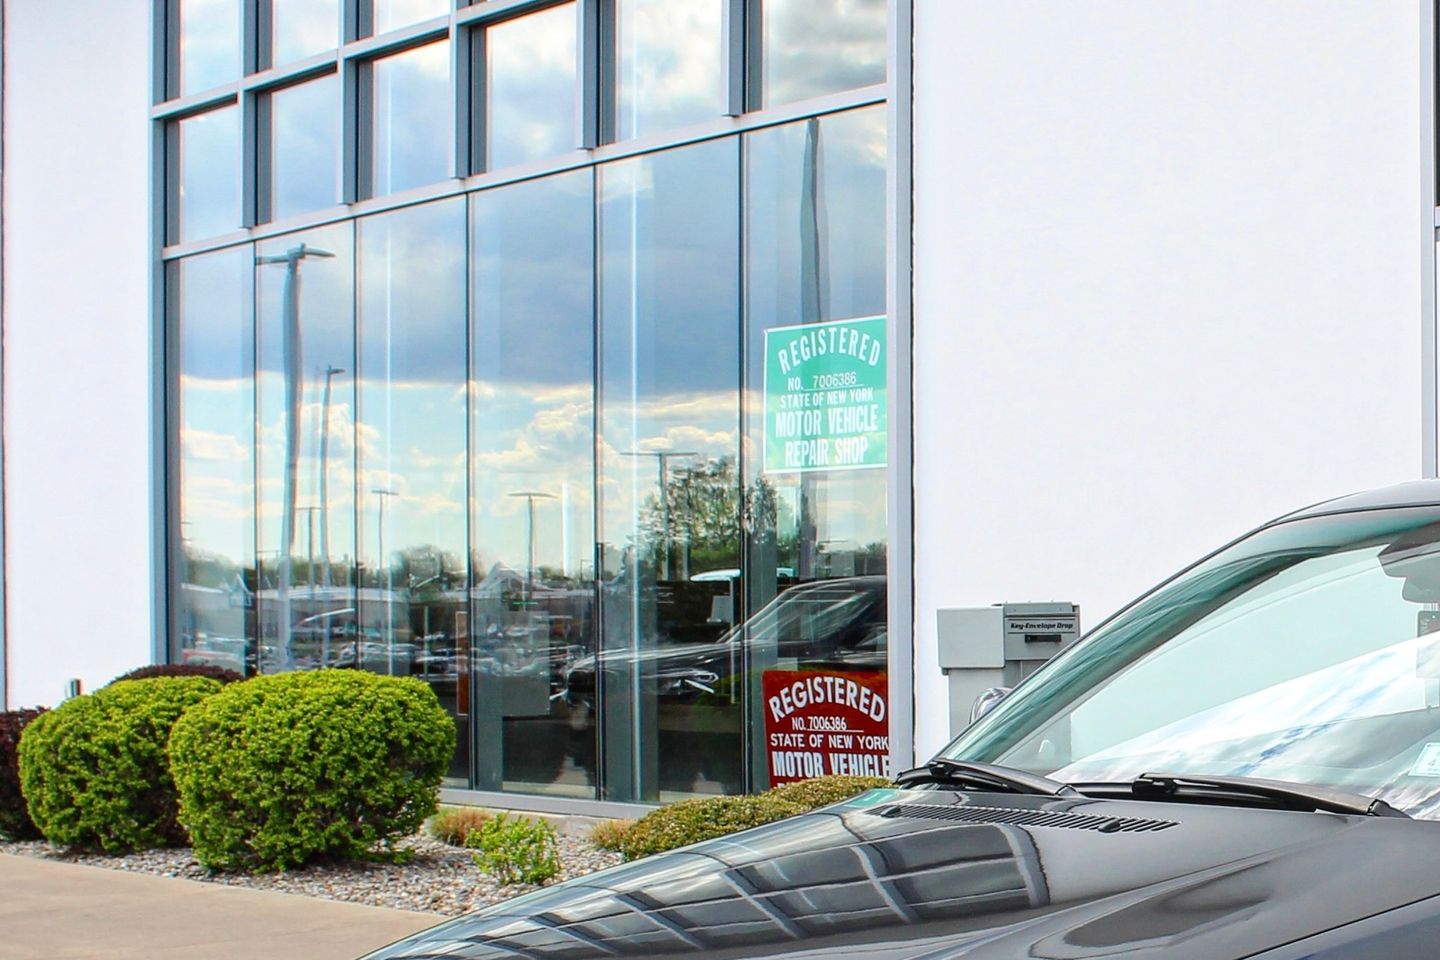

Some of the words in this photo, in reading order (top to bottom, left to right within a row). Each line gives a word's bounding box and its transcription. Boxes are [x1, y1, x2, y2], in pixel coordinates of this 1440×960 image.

[778, 327, 881, 375] REGISTERED
[788, 377, 804, 391] NO.
[812, 371, 857, 388] 7006386
[780, 393, 810, 409] STATE
[812, 393, 825, 407] OF
[827, 390, 847, 406] NEW
[849, 387, 874, 403] YORK
[775, 409, 822, 438] MOTOR
[828, 404, 879, 435] VEHICLE
[784, 438, 829, 467] REPAIR
[834, 436, 869, 465] SHOP
[1056, 622, 1074, 630] Drop
[768, 676, 886, 724] REGISTERED
[792, 717, 806, 731] NO.
[807, 716, 848, 731] 7006386
[770, 733, 805, 748] STATE
[809, 734, 825, 748] OF
[829, 735, 853, 749] NEW
[857, 735, 889, 750] YORK
[772, 751, 824, 778] MOTOR
[829, 753, 890, 777] VEHICLE
